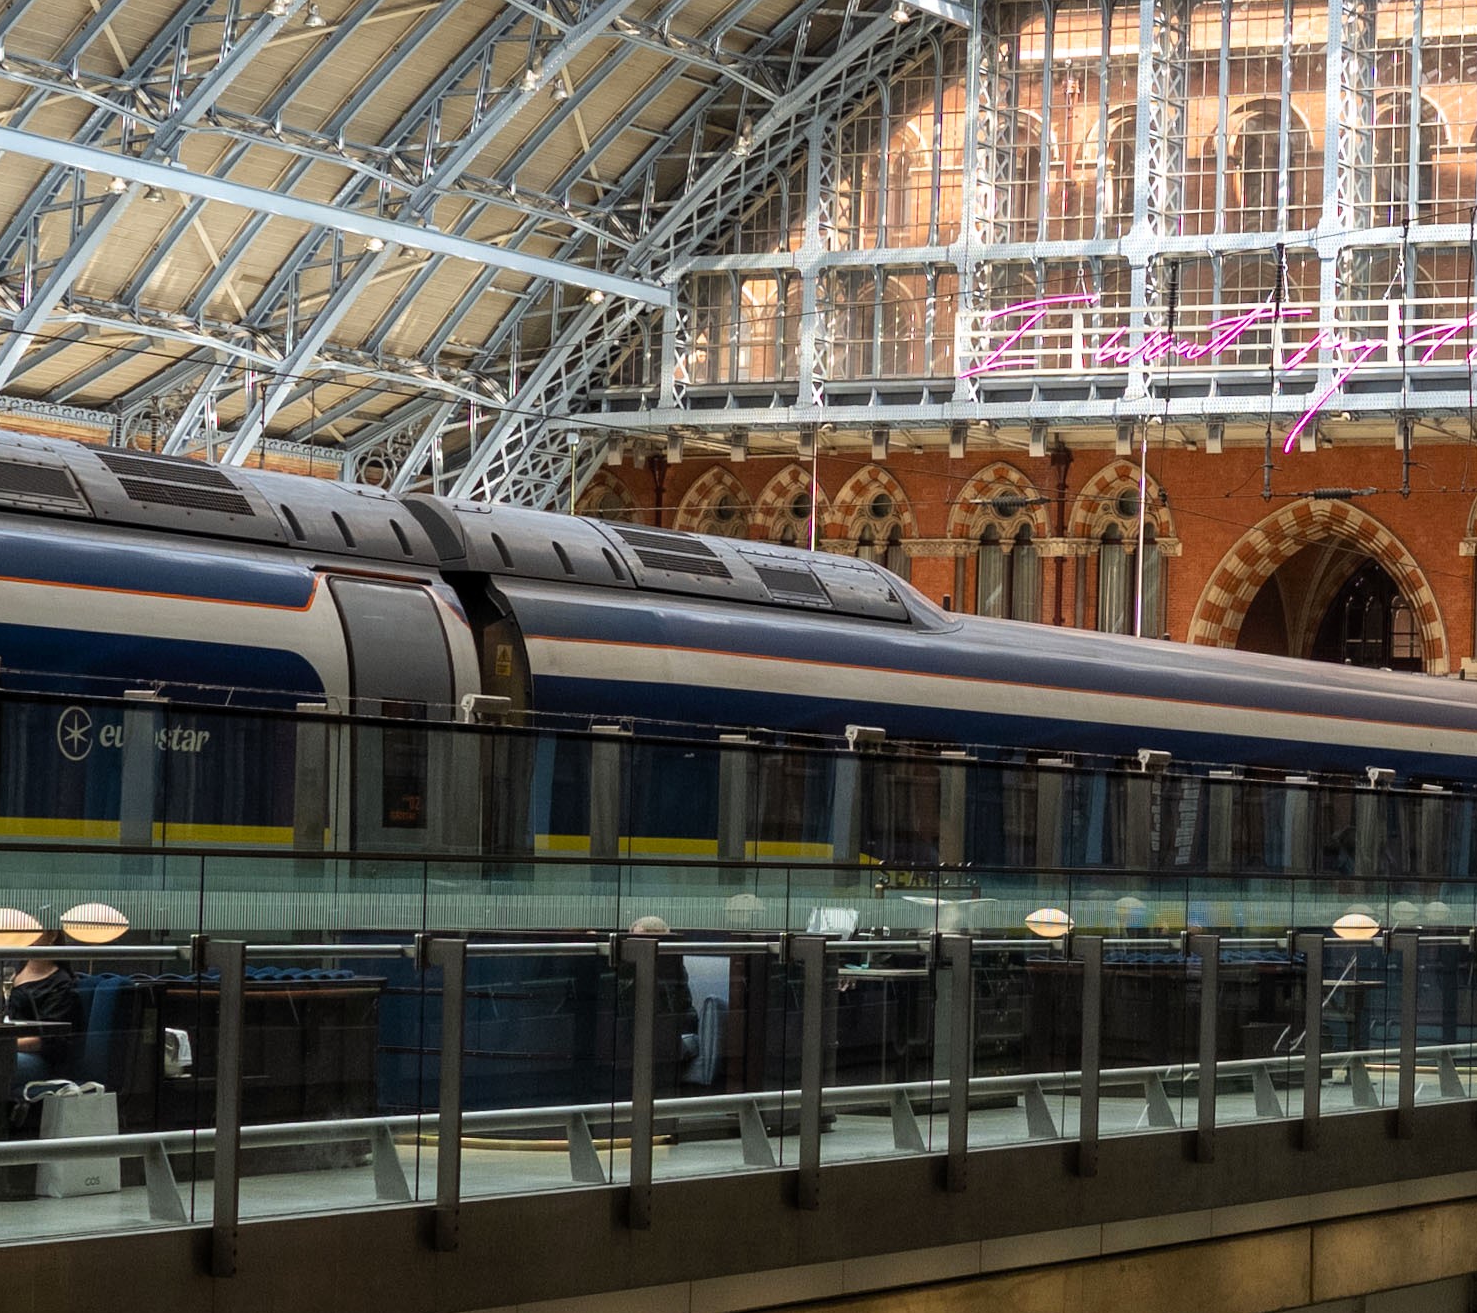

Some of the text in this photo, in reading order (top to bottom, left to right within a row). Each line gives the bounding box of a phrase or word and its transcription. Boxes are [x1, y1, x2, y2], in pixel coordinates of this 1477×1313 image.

[960, 294, 1100, 379] I
[99, 723, 210, 752] eustar
[84, 1176, 101, 1187] COS
